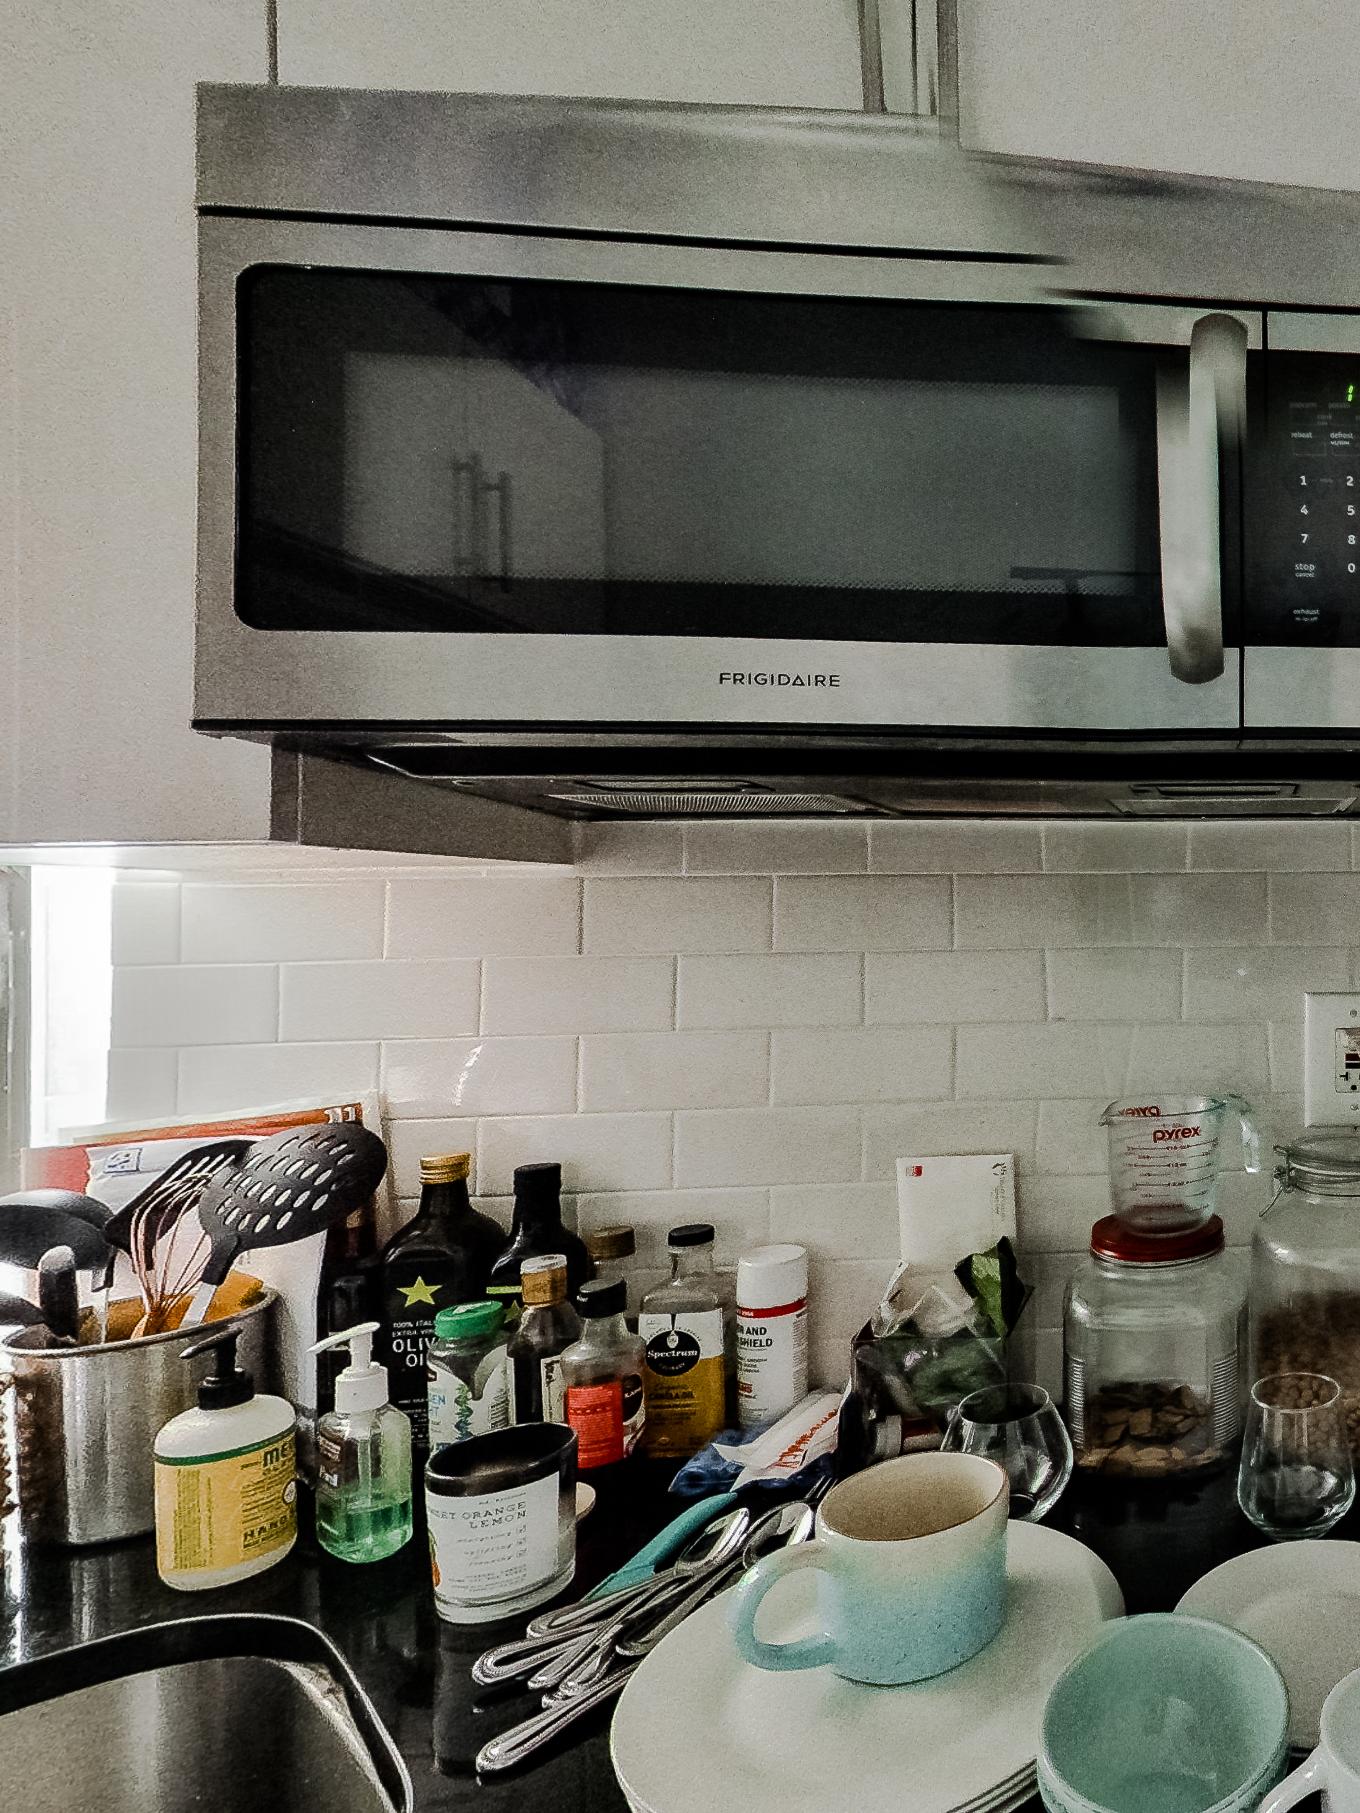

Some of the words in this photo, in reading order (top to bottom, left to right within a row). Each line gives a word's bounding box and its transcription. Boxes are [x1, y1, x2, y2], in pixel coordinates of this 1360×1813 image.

[1330, 431, 1354, 440] defrost
[1299, 475, 1307, 486] 1
[1346, 476, 1354, 487] 2
[1300, 505, 1309, 515] 4
[1347, 505, 1355, 516] 5
[1301, 534, 1309, 544] 7
[1347, 535, 1356, 545] 8
[1294, 563, 1315, 572] stop
[1347, 562, 1356, 573] 0
[719, 672, 841, 687] FRIGIDAIRE
[1152, 1126, 1200, 1143] pyrex
[745, 1326, 767, 1336] AND
[392, 1337, 437, 1353] OLIV
[647, 1349, 698, 1360] Spectrum
[405, 1353, 424, 1368] OI
[462, 1501, 527, 1519] ORANGE
[469, 1509, 527, 1529] LEMON
